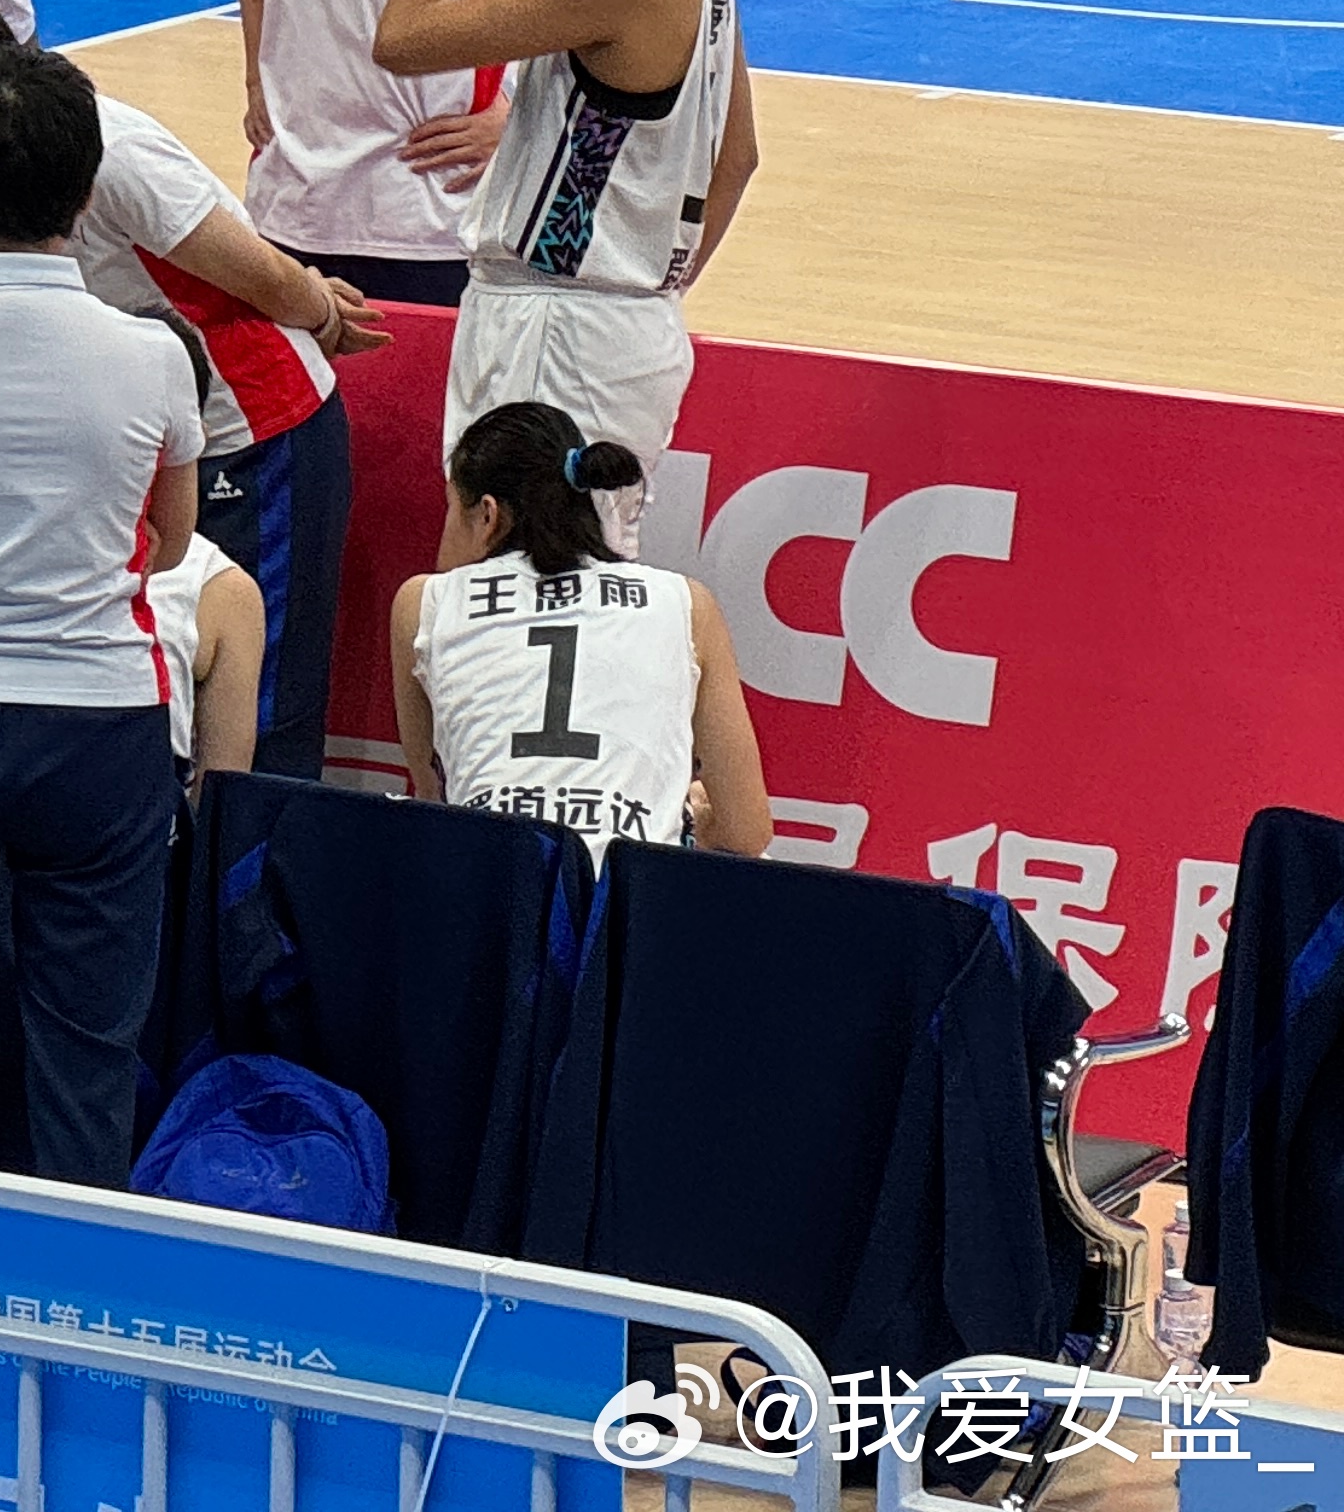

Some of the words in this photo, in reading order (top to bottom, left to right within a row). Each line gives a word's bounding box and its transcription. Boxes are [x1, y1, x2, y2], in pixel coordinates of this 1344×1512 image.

[468, 573, 649, 620] 王思雨
[510, 624, 601, 760] 1
